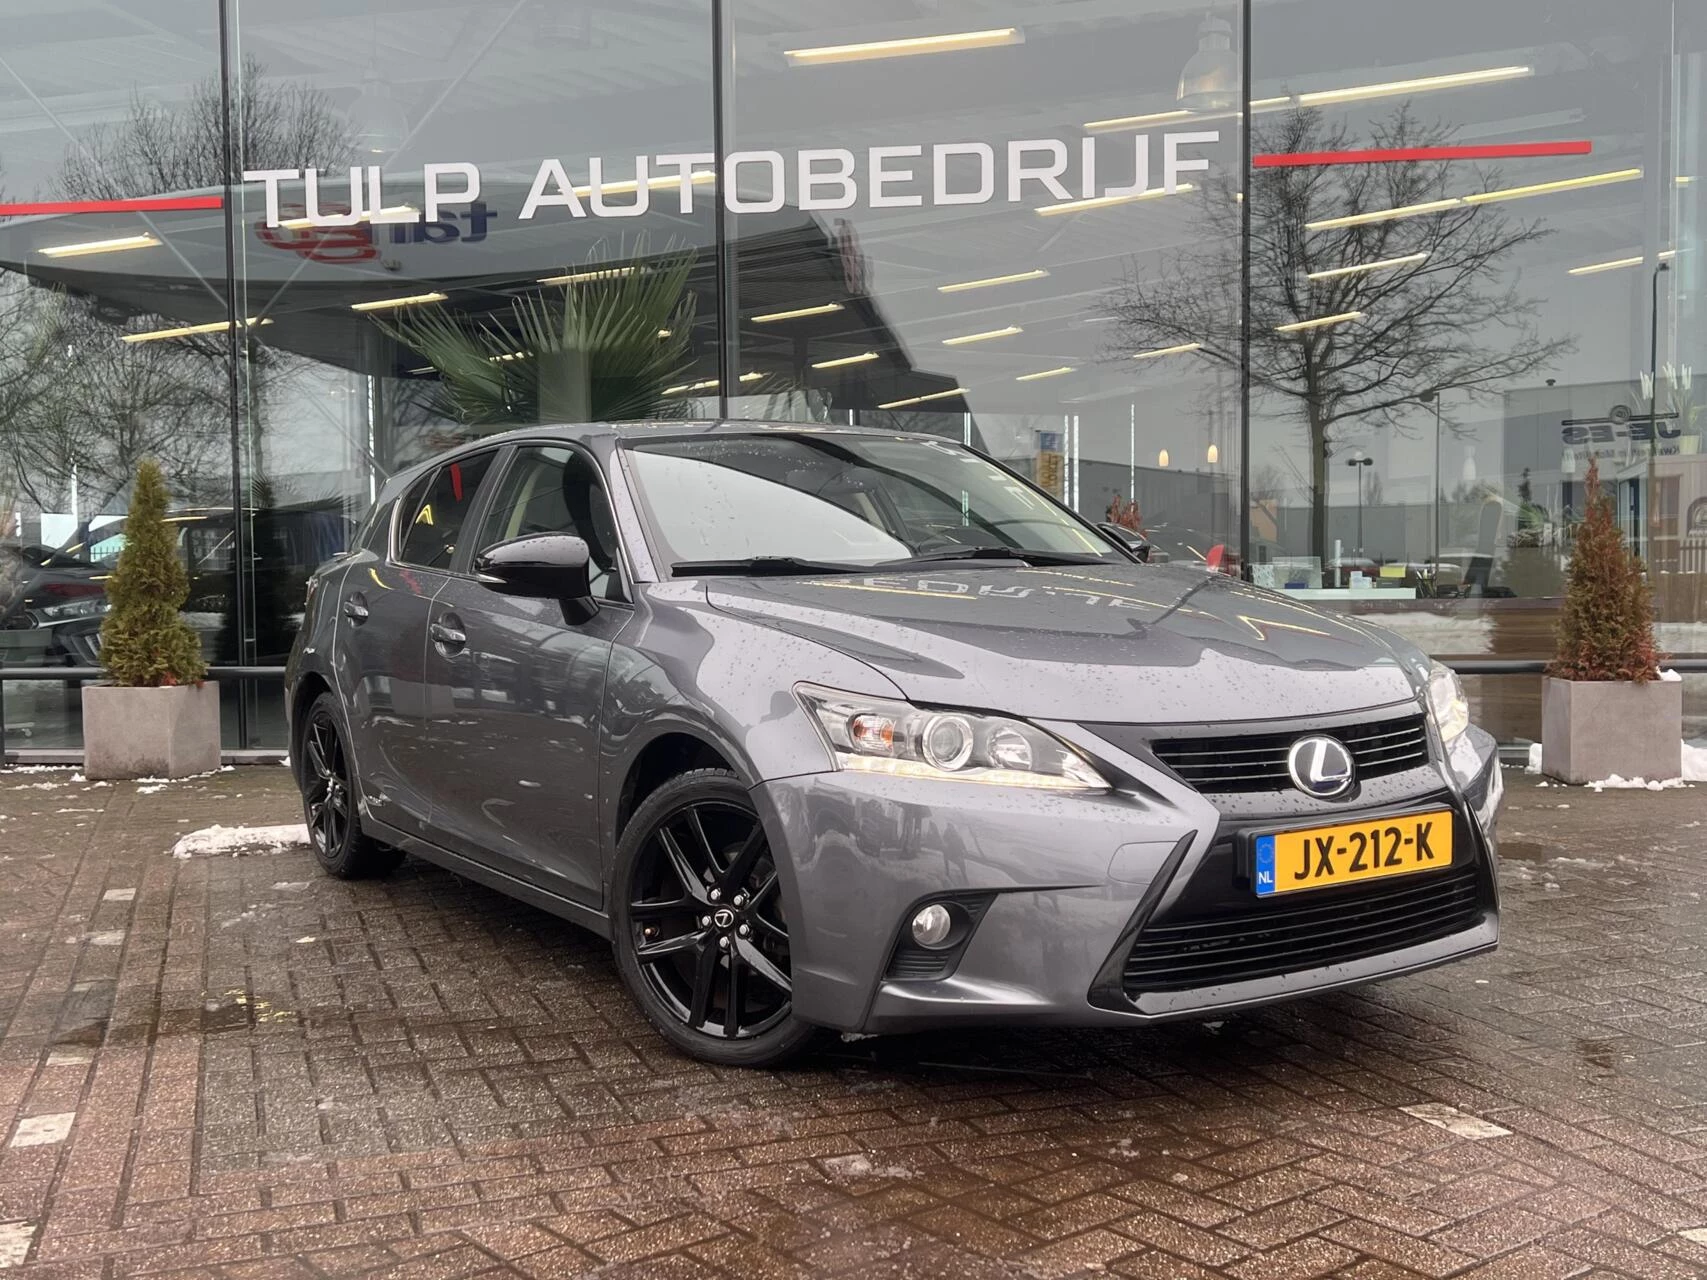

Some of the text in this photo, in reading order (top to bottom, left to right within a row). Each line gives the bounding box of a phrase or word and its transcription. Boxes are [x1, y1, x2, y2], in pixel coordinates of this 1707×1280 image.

[243, 131, 1220, 228] TULP AUTOBEDRIJF
[1258, 871, 1273, 885] NL
[1294, 821, 1435, 881] JX-212-K
